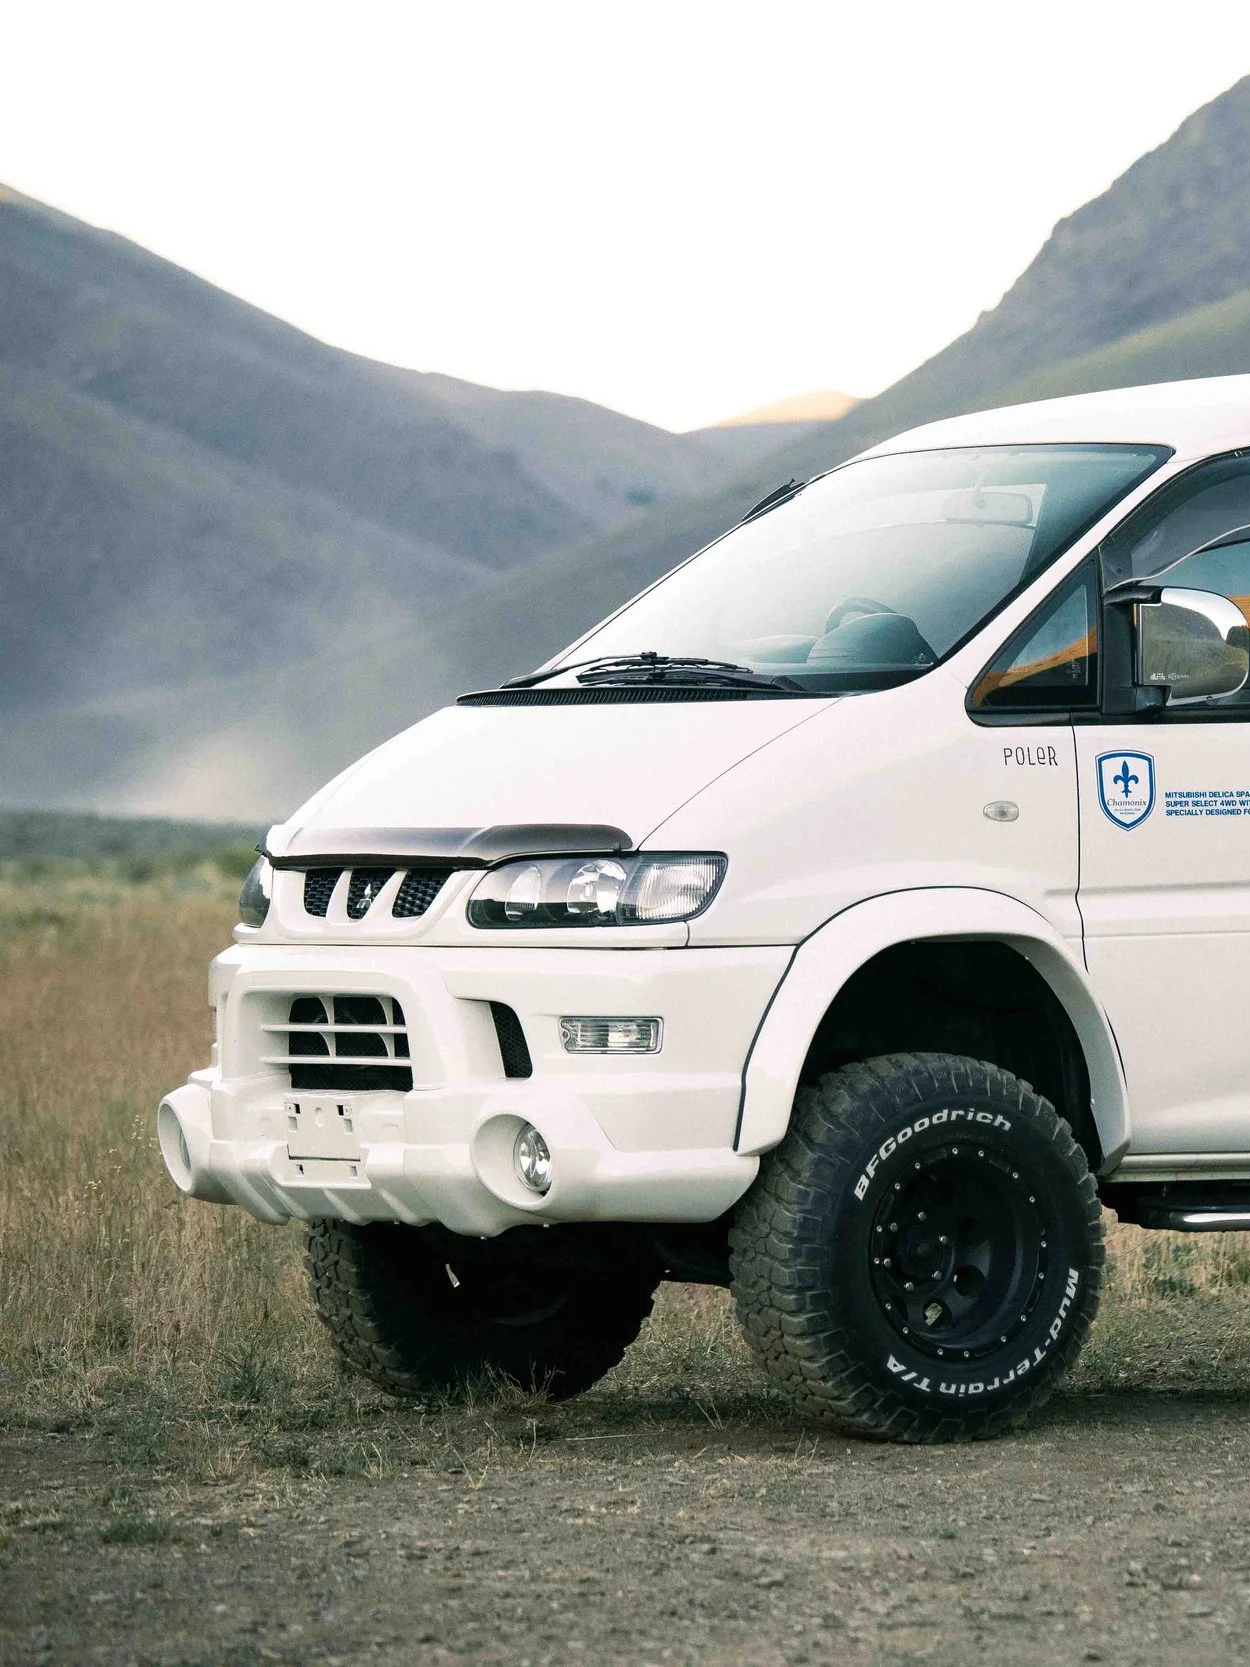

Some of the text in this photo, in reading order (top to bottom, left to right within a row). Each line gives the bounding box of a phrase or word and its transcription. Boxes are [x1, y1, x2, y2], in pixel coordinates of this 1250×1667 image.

[1165, 791, 1207, 799] MITSUBISHI
[1107, 799, 1147, 807] Chamonix
[1205, 808, 1242, 816] DESIGNED
[853, 1107, 1012, 1201] BFGoodrich
[886, 1268, 1079, 1395] Mud-Terrain T/A
